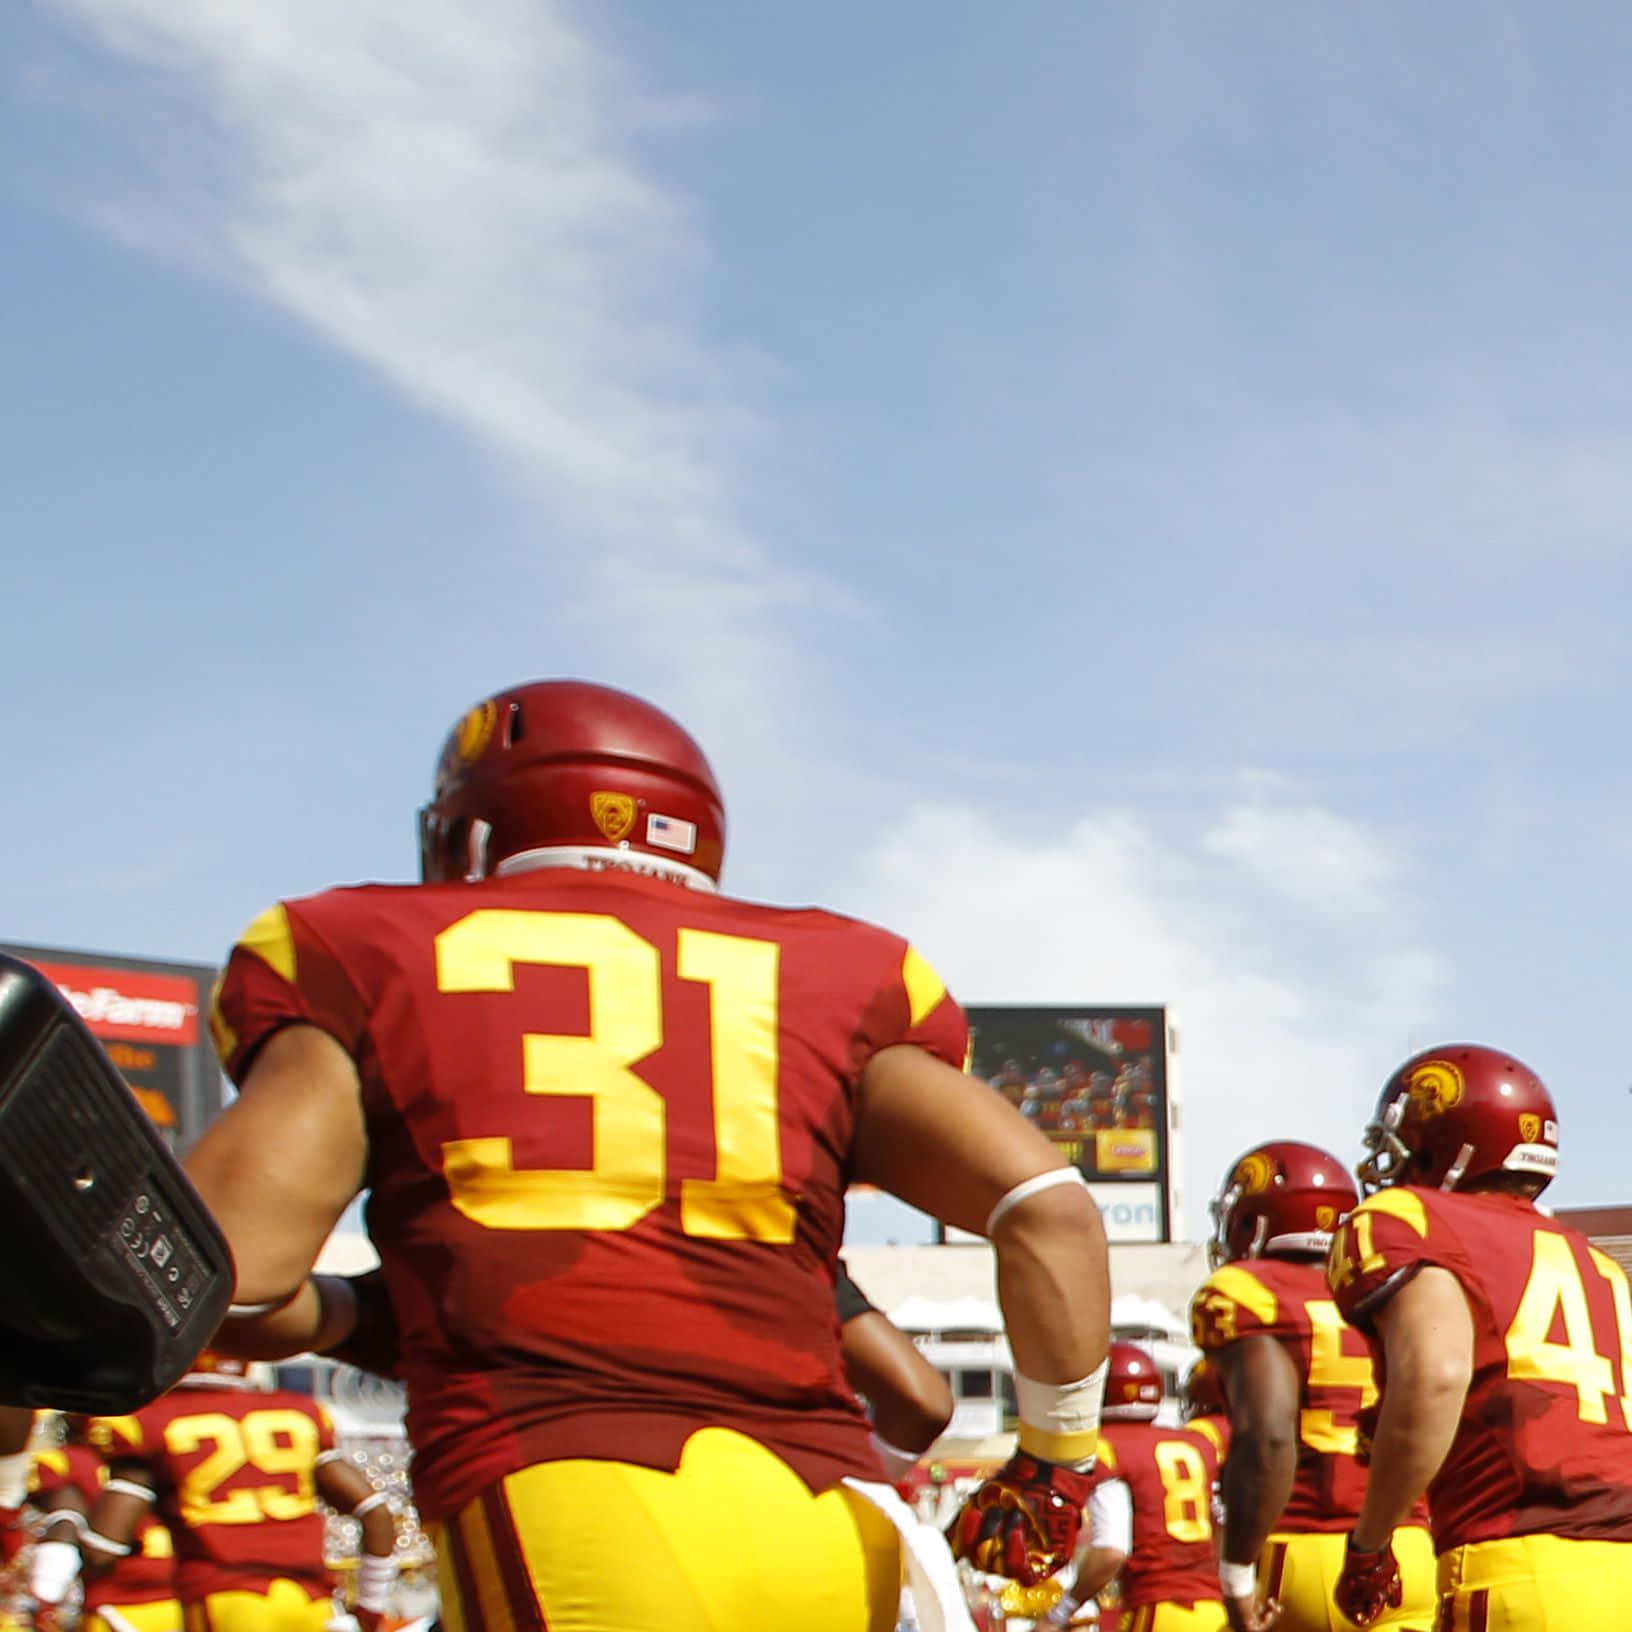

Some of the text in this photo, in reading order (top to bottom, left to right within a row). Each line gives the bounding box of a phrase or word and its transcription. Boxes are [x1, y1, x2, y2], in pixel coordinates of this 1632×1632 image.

[434, 908, 797, 1244] 31
[1301, 1299, 1381, 1456] 5
[163, 1408, 318, 1526] 29
[1153, 1439, 1213, 1543] 8
